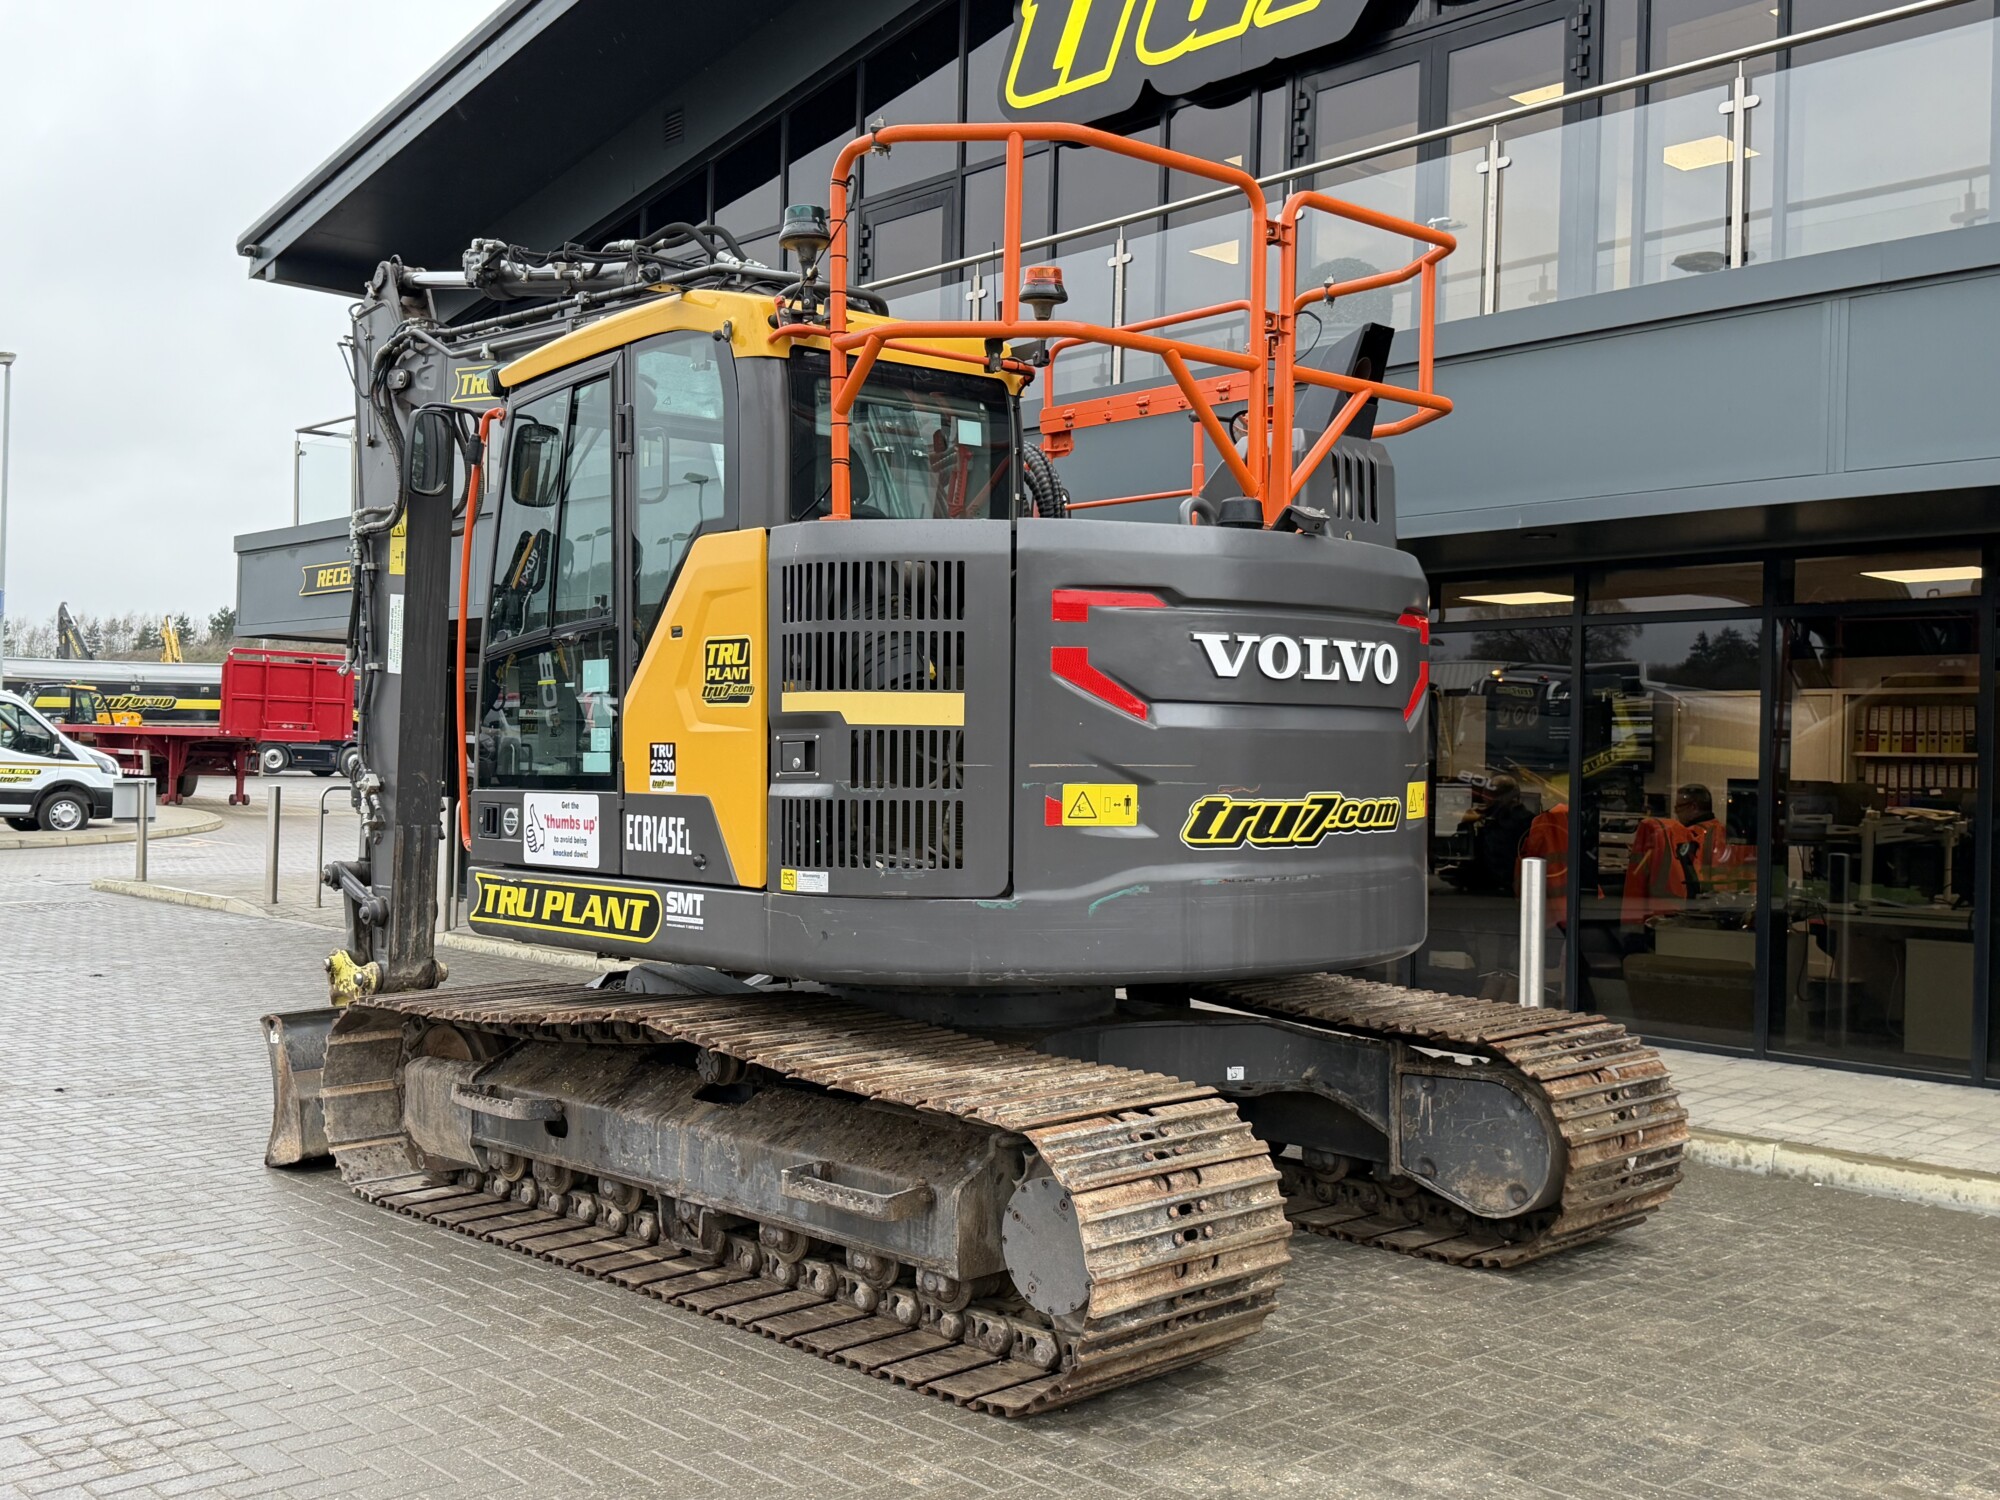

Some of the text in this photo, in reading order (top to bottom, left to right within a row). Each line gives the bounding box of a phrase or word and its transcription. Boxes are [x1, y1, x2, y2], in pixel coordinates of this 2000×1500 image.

[707, 643, 748, 666] TRU
[1193, 633, 1398, 685] VOLVO
[706, 667, 750, 681] PLANT
[702, 684, 754, 699] tru7.com
[652, 744, 673, 758] TRU
[651, 760, 675, 773] 2530
[561, 801, 570, 809] Get
[1184, 796, 1399, 843] tru7.com
[574, 837, 587, 846] being
[553, 849, 573, 857] knocked
[484, 883, 650, 932] TRU PLANT
[666, 891, 704, 916] SMT
